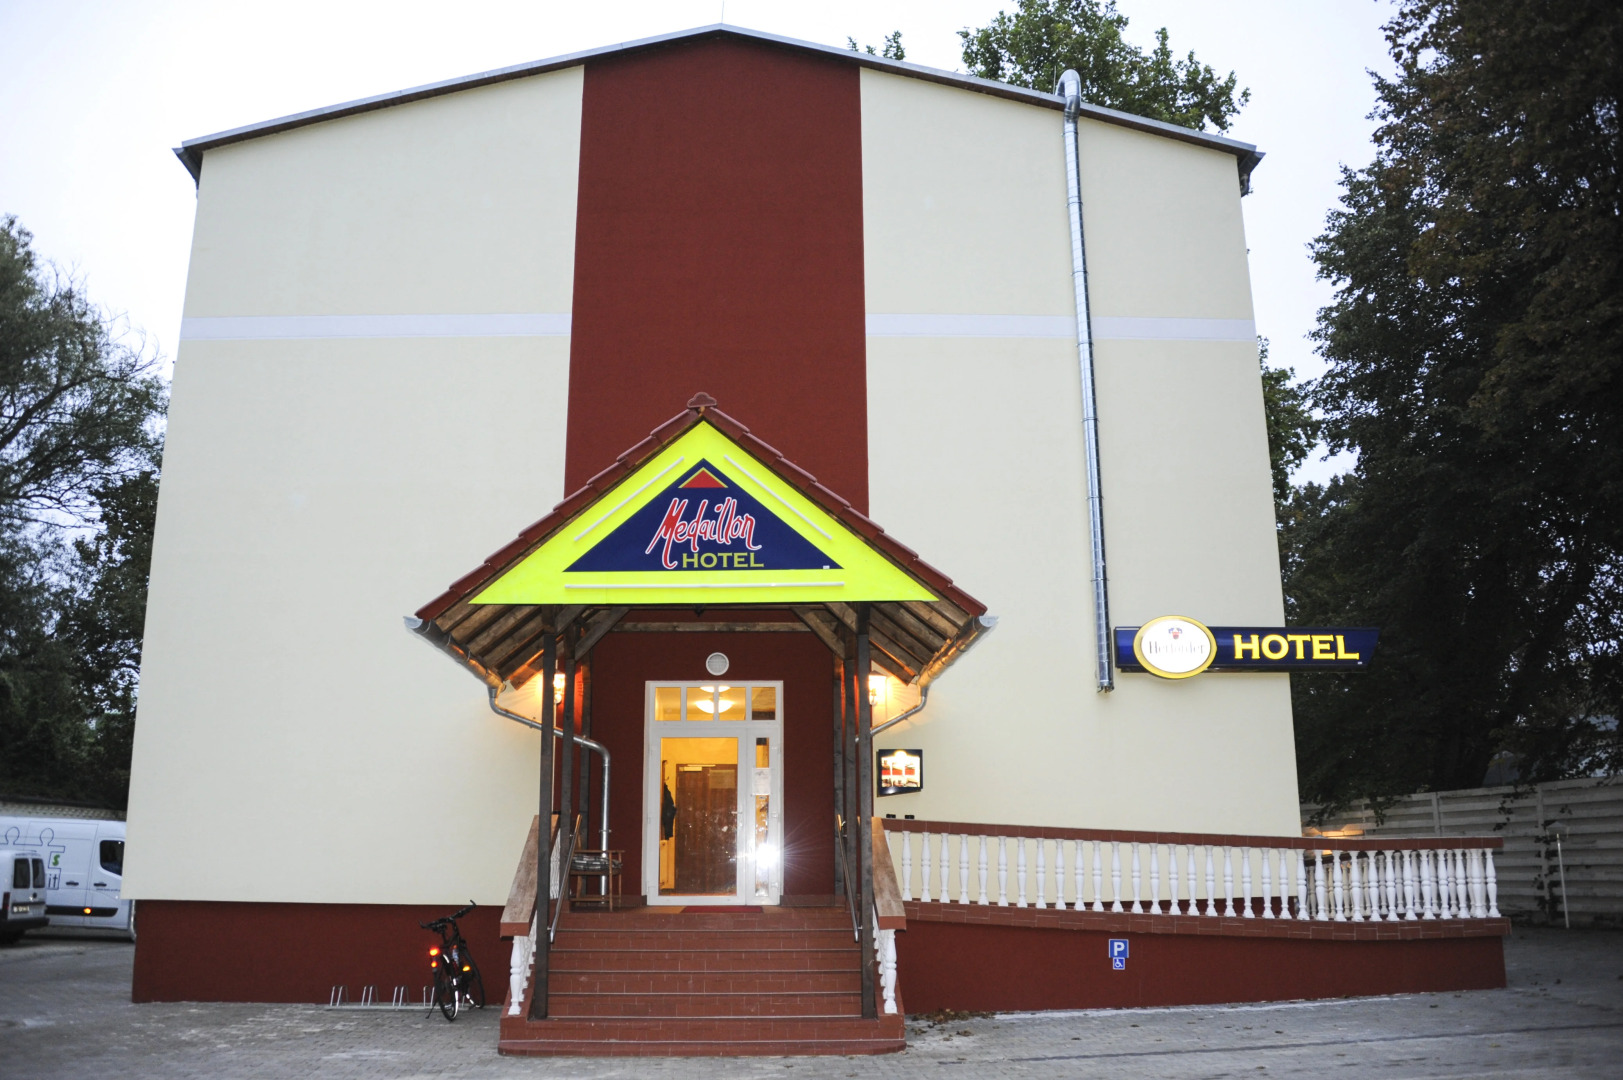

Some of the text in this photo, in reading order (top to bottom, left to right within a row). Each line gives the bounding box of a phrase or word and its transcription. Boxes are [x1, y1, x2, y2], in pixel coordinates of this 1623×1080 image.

[645, 497, 762, 569] Medaillon
[682, 552, 764, 568] HOTEL
[1233, 634, 1360, 660] HOTEL
[1114, 941, 1125, 956] P
